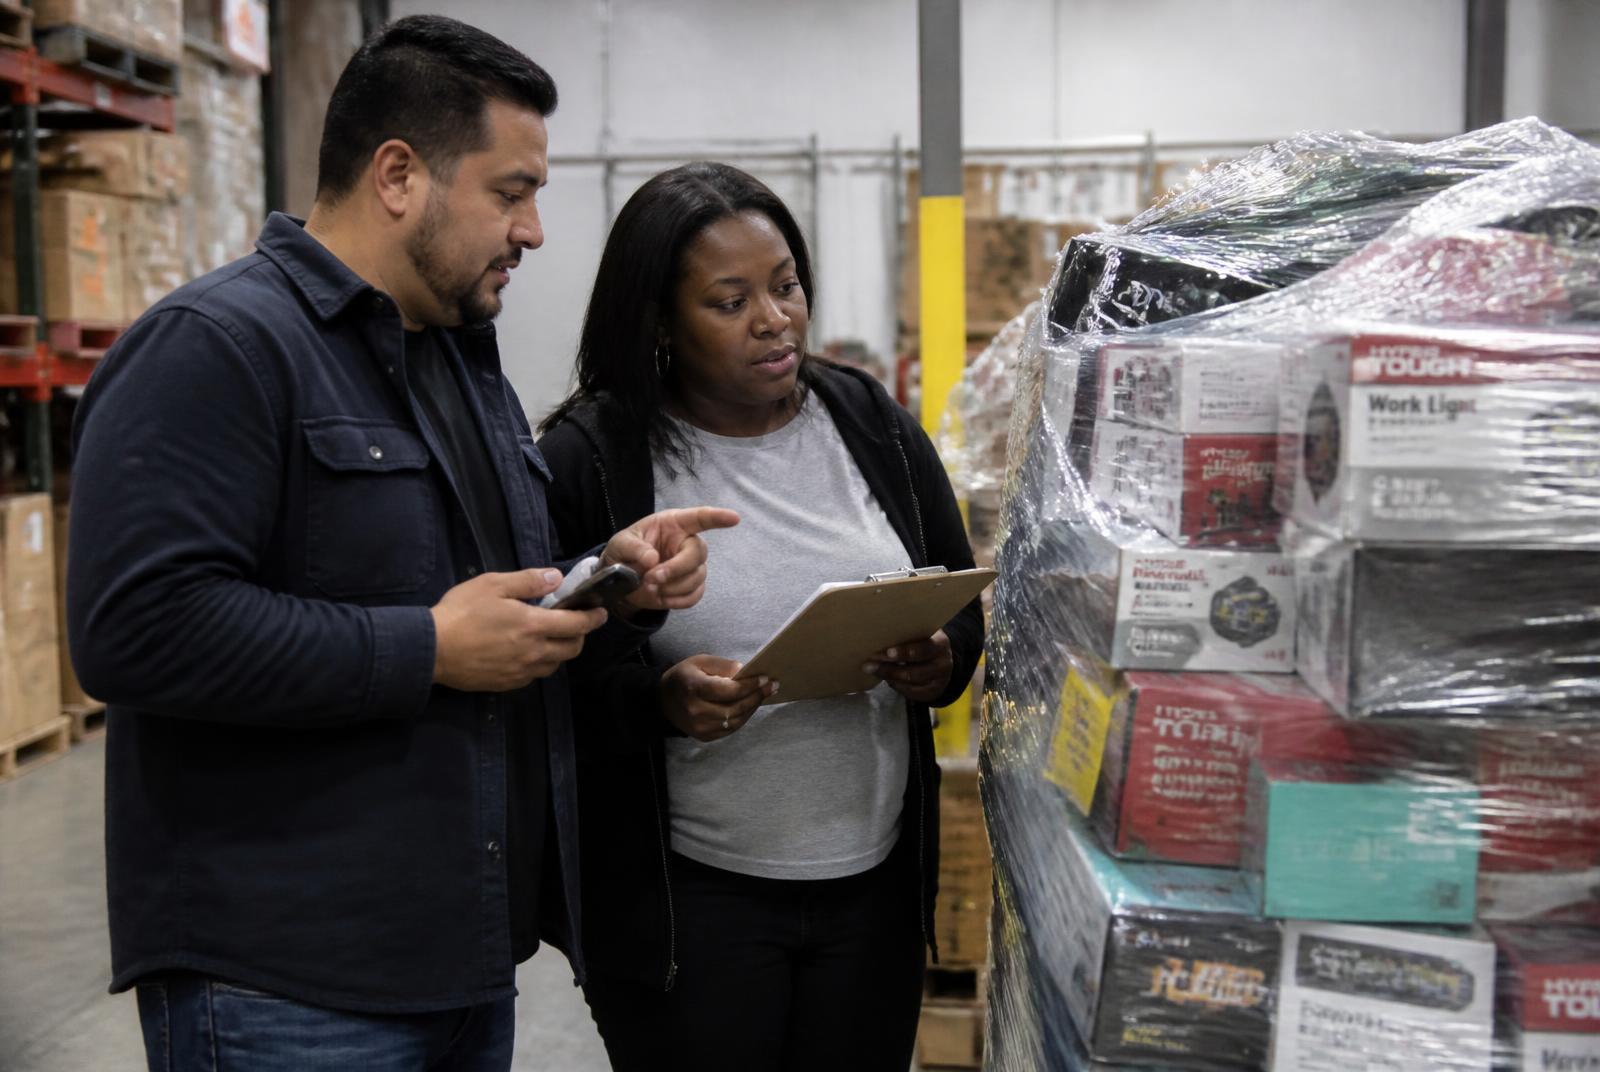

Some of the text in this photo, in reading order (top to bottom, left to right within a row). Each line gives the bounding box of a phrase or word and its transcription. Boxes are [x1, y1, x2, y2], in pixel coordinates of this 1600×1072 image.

[1365, 357, 1472, 377] TOUGH
[1368, 394, 1421, 414] Work
[1543, 979, 1600, 995] HYP
